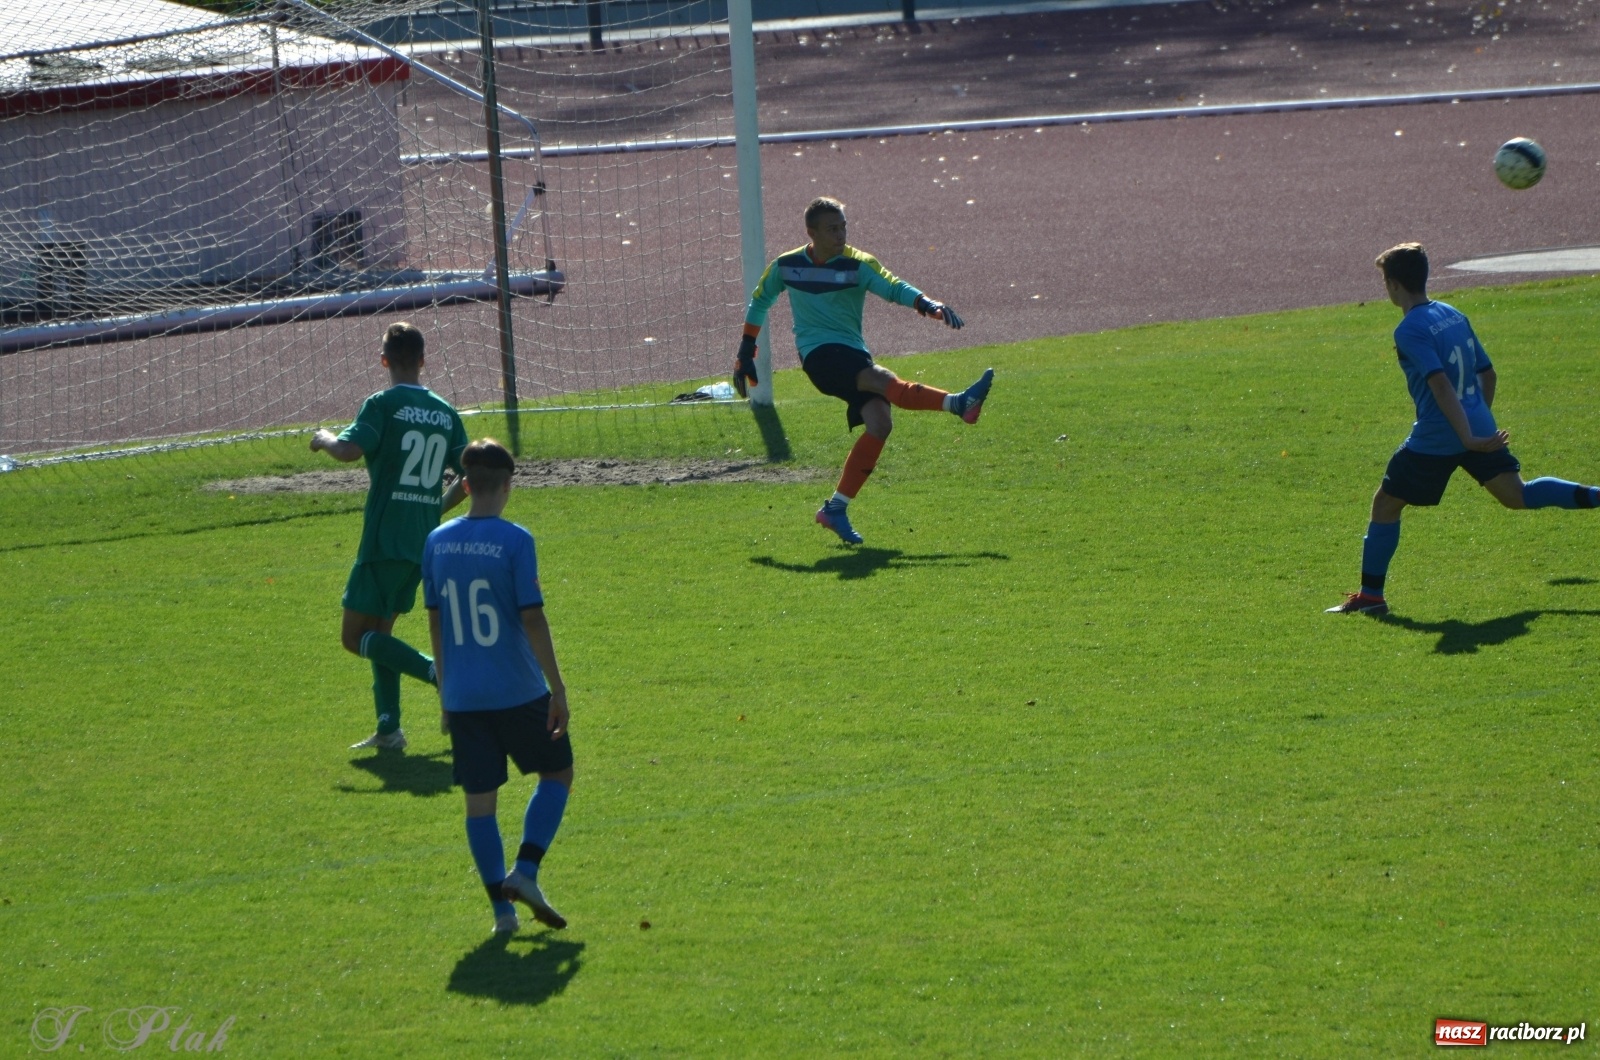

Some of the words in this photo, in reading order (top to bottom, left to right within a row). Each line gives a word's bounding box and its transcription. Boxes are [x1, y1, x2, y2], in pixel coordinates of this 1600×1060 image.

[393, 406, 453, 430] REKORD
[399, 430, 447, 489] 20
[441, 542, 462, 554] UNIA
[440, 578, 499, 648] 16
